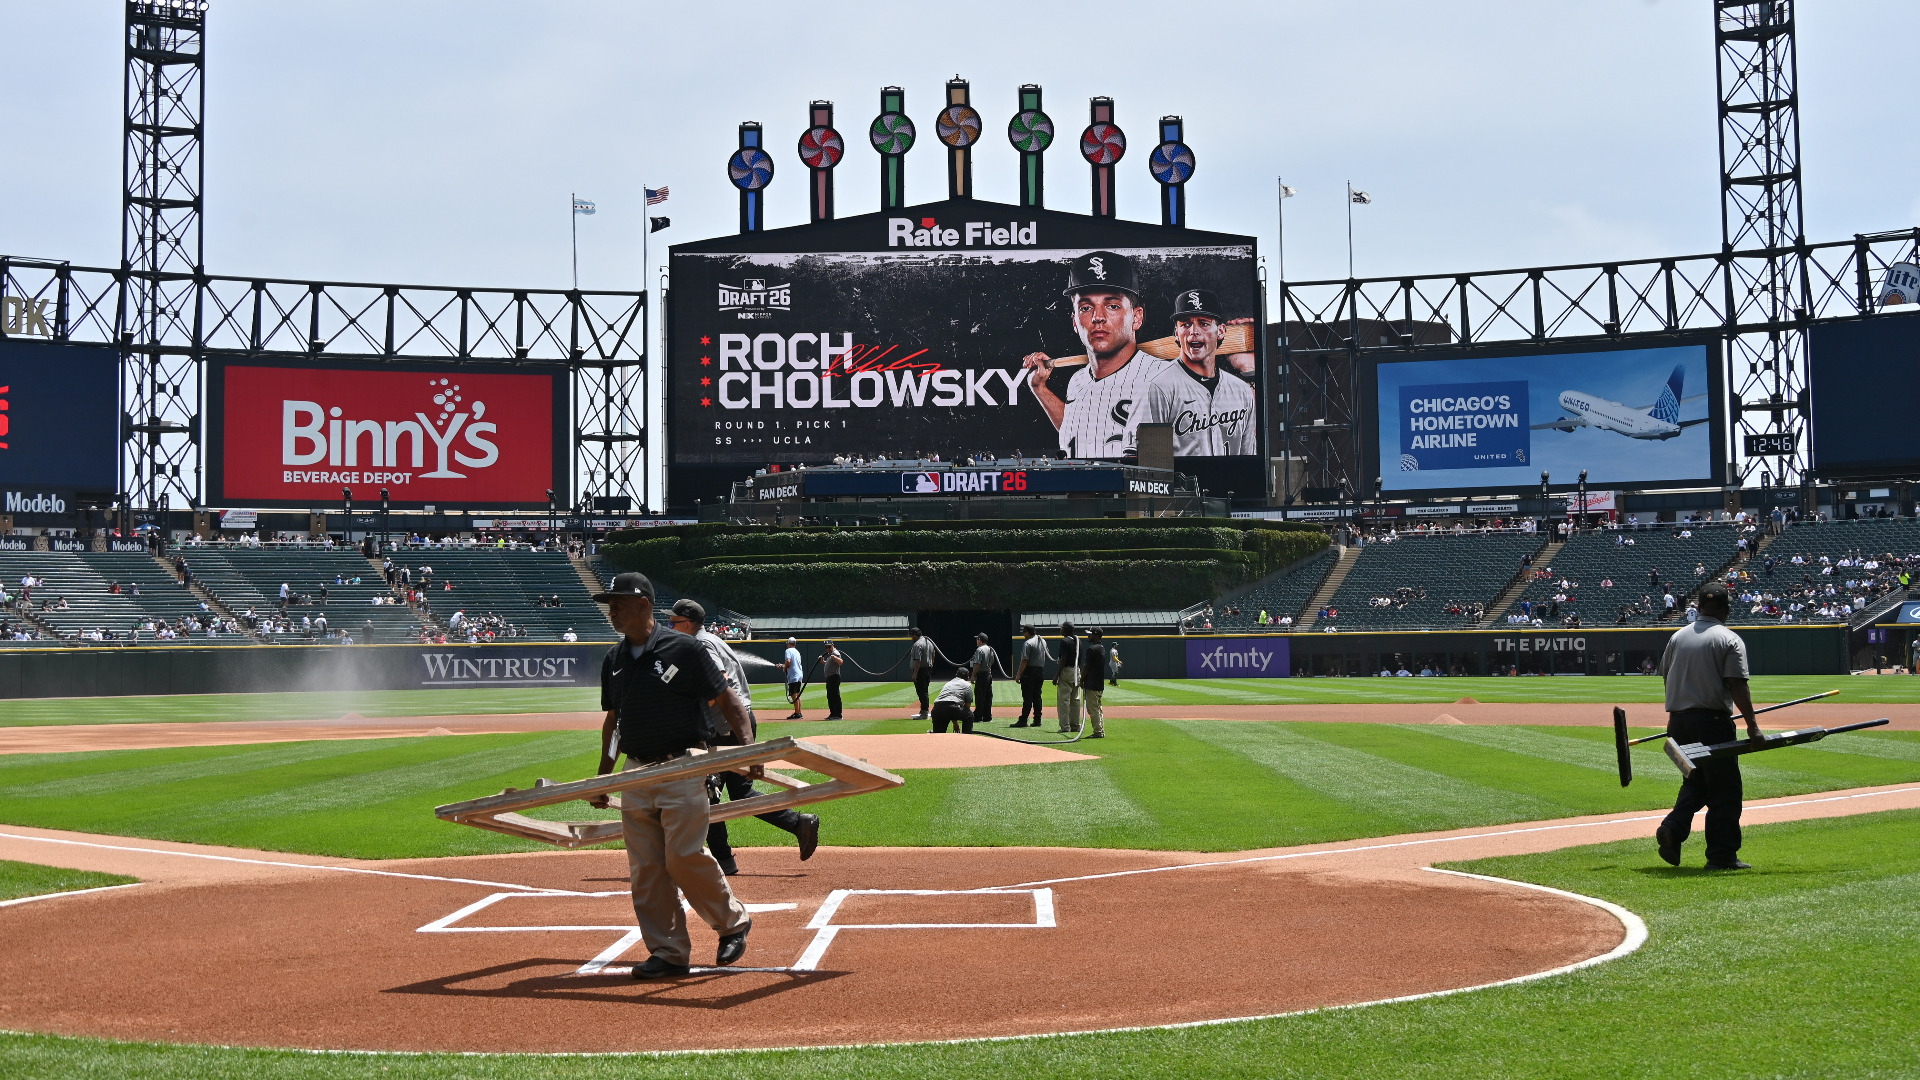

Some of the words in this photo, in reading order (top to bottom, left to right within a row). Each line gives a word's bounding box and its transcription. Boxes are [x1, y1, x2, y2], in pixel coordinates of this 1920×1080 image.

[888, 217, 960, 247] Rate
[965, 221, 1037, 246] Field
[1886, 269, 1918, 290] Lite
[718, 288, 768, 306] DRAFT
[769, 288, 791, 306] 26
[719, 332, 853, 371] ROCH
[718, 368, 1030, 409] CHOLOWSKY
[1410, 395, 1511, 414] CHICAGO'S
[714, 420, 765, 430] ROUND
[796, 420, 831, 430] PICK
[842, 420, 847, 429] 1
[1174, 407, 1248, 437] Chicago
[1410, 414, 1519, 432] HOMETOWN
[715, 436, 732, 445] SS
[773, 436, 812, 444] UCLA
[1410, 432, 1477, 450] AIRLINE
[1752, 436, 1792, 452] 12:46
[284, 471, 360, 484] BEVERAGE
[364, 472, 412, 484] DEPOT
[944, 472, 1002, 492] DRAFT
[1002, 471, 1027, 490] 26
[759, 488, 775, 500] FAN
[776, 484, 798, 498] DECK
[1129, 480, 1146, 493] FAN
[1148, 482, 1170, 495] DECK
[6, 492, 66, 514] Modelo
[112, 540, 142, 552] Modelo
[1494, 638, 1530, 652] THE
[1534, 638, 1586, 651] PATIO
[1200, 646, 1274, 672] xfinity
